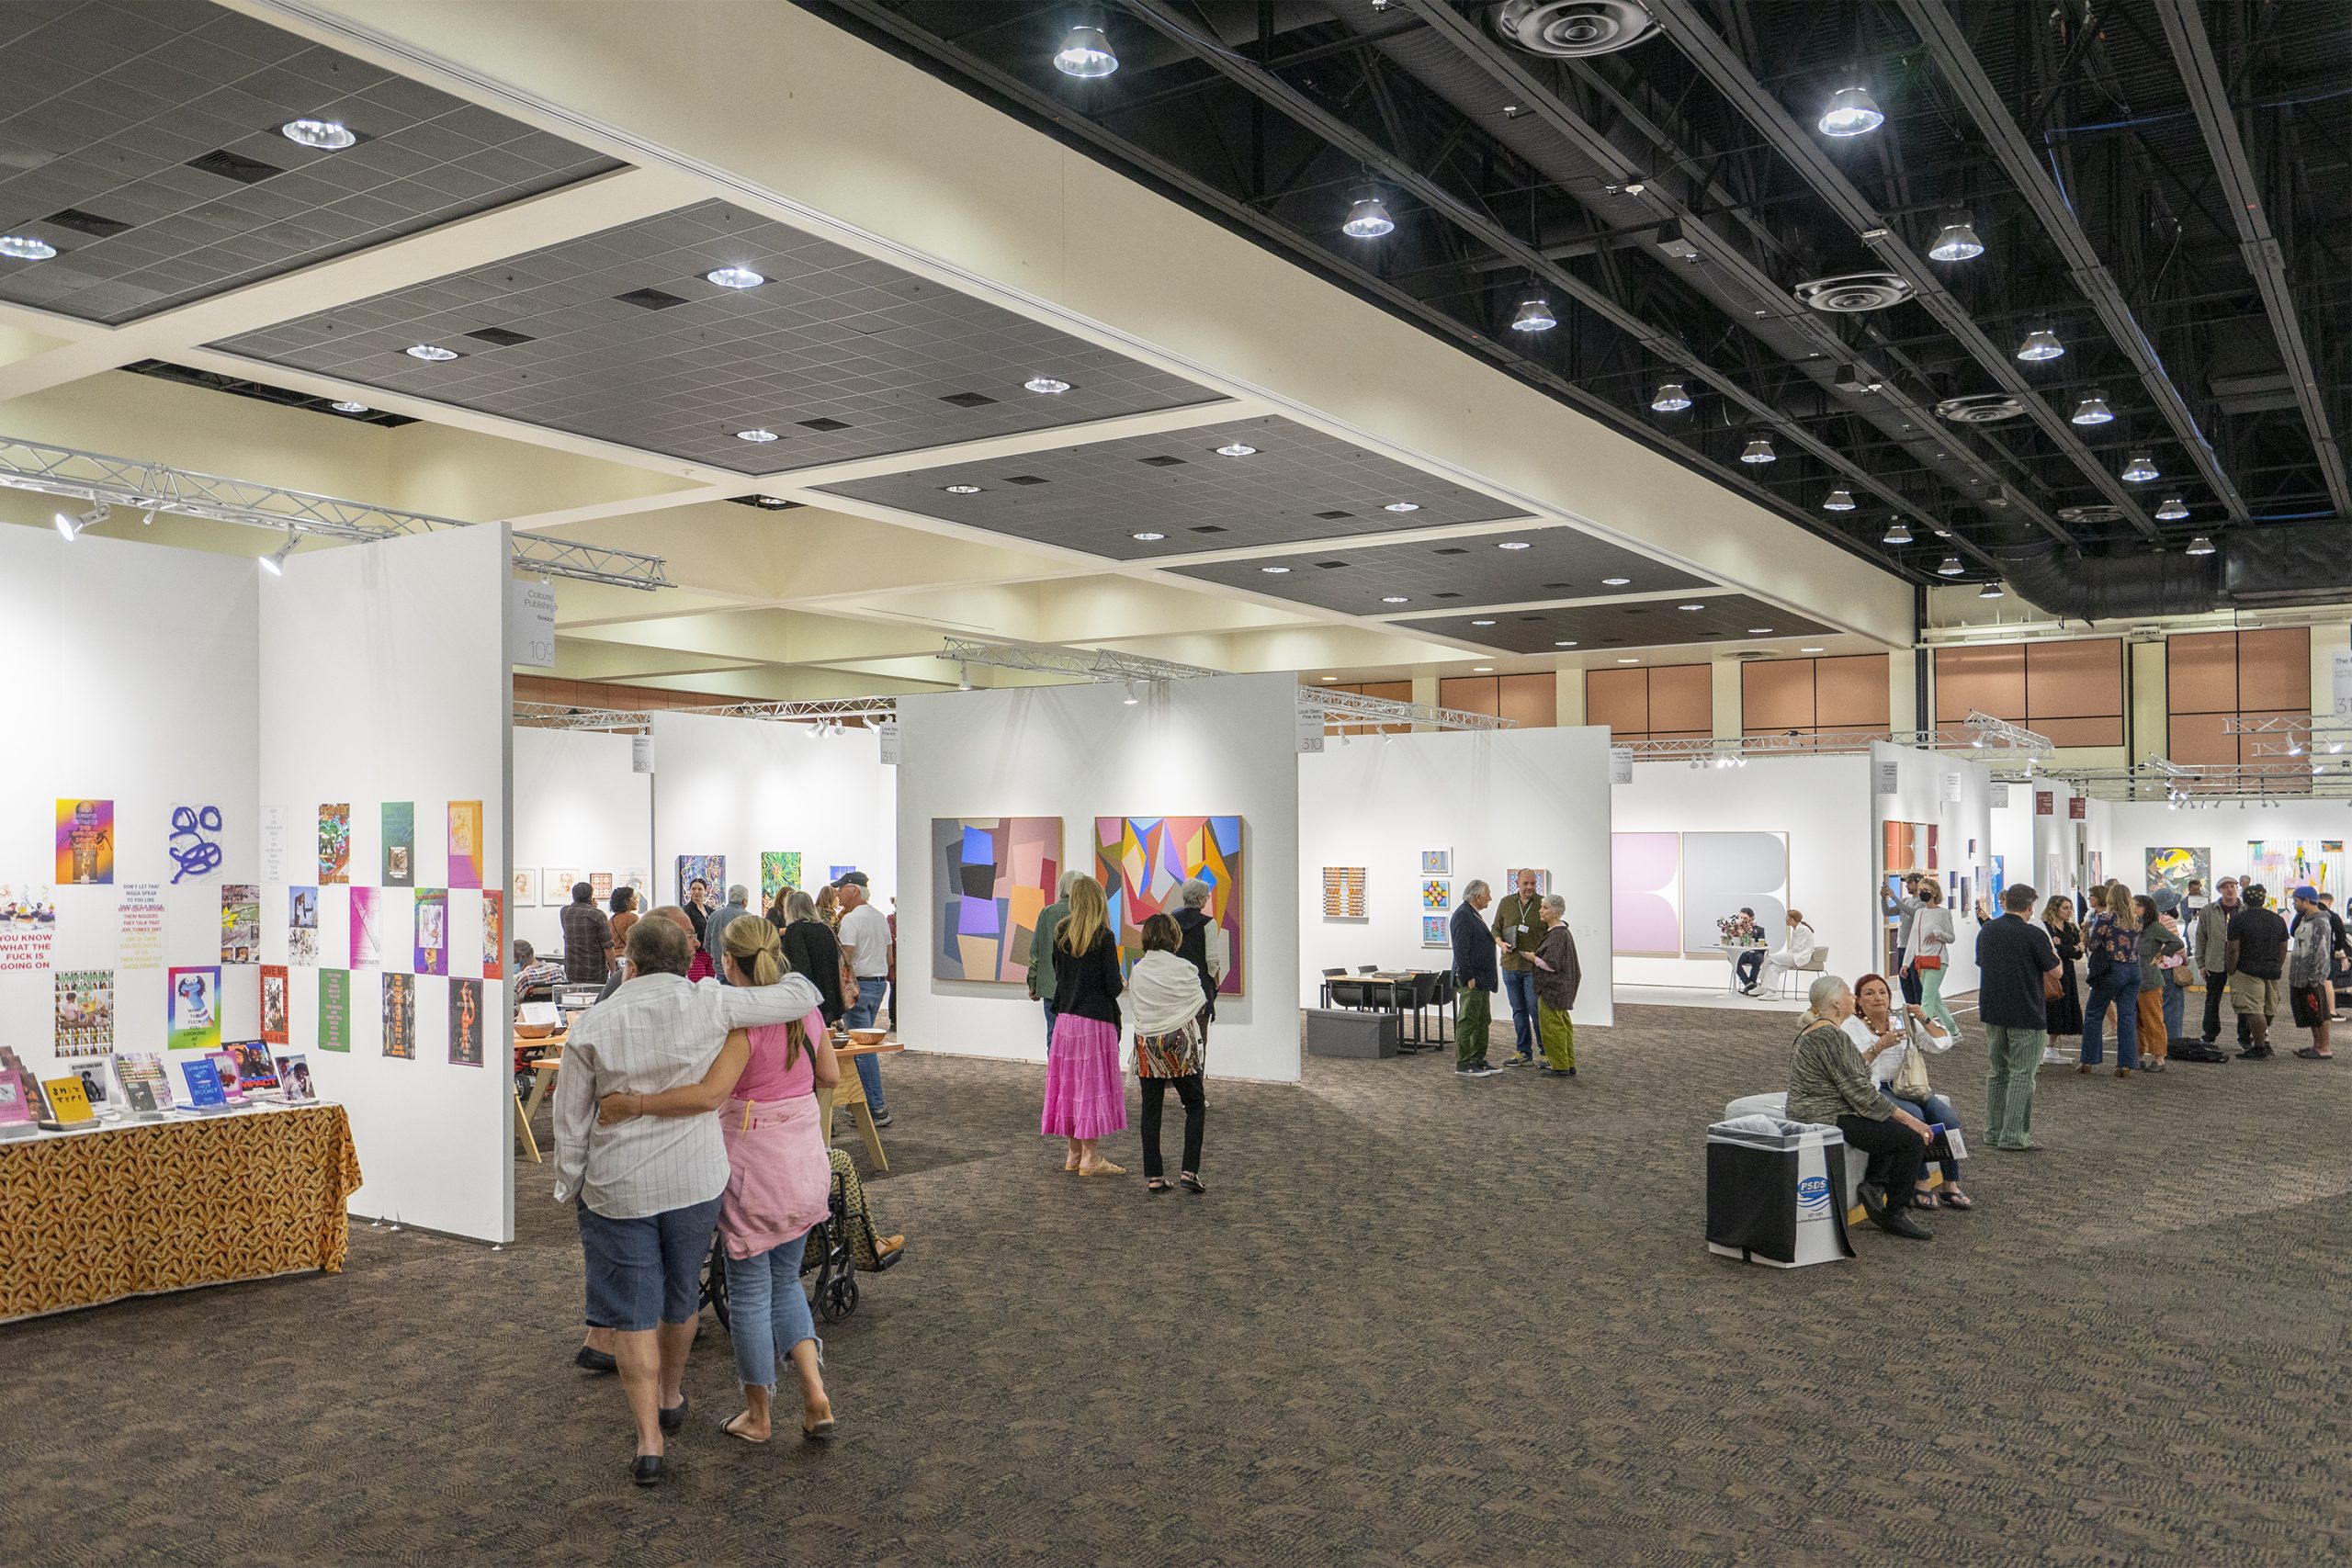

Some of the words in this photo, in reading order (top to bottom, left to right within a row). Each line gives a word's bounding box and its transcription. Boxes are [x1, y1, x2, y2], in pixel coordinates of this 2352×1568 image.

[529, 641, 553, 661] 109
[1302, 738, 1322, 750] 310
[1616, 772, 1632, 782] 310
[22, 933, 52, 942] KNOW
[6, 953, 33, 961] FUCK
[35, 952, 44, 960] IS
[0, 962, 33, 970] GOING
[260, 965, 277, 976] LOVE
[277, 966, 288, 977] ME
[265, 977, 277, 986] BUT
[241, 1078, 277, 1088] MPACT
[1801, 1179, 1826, 1190] PSDS
